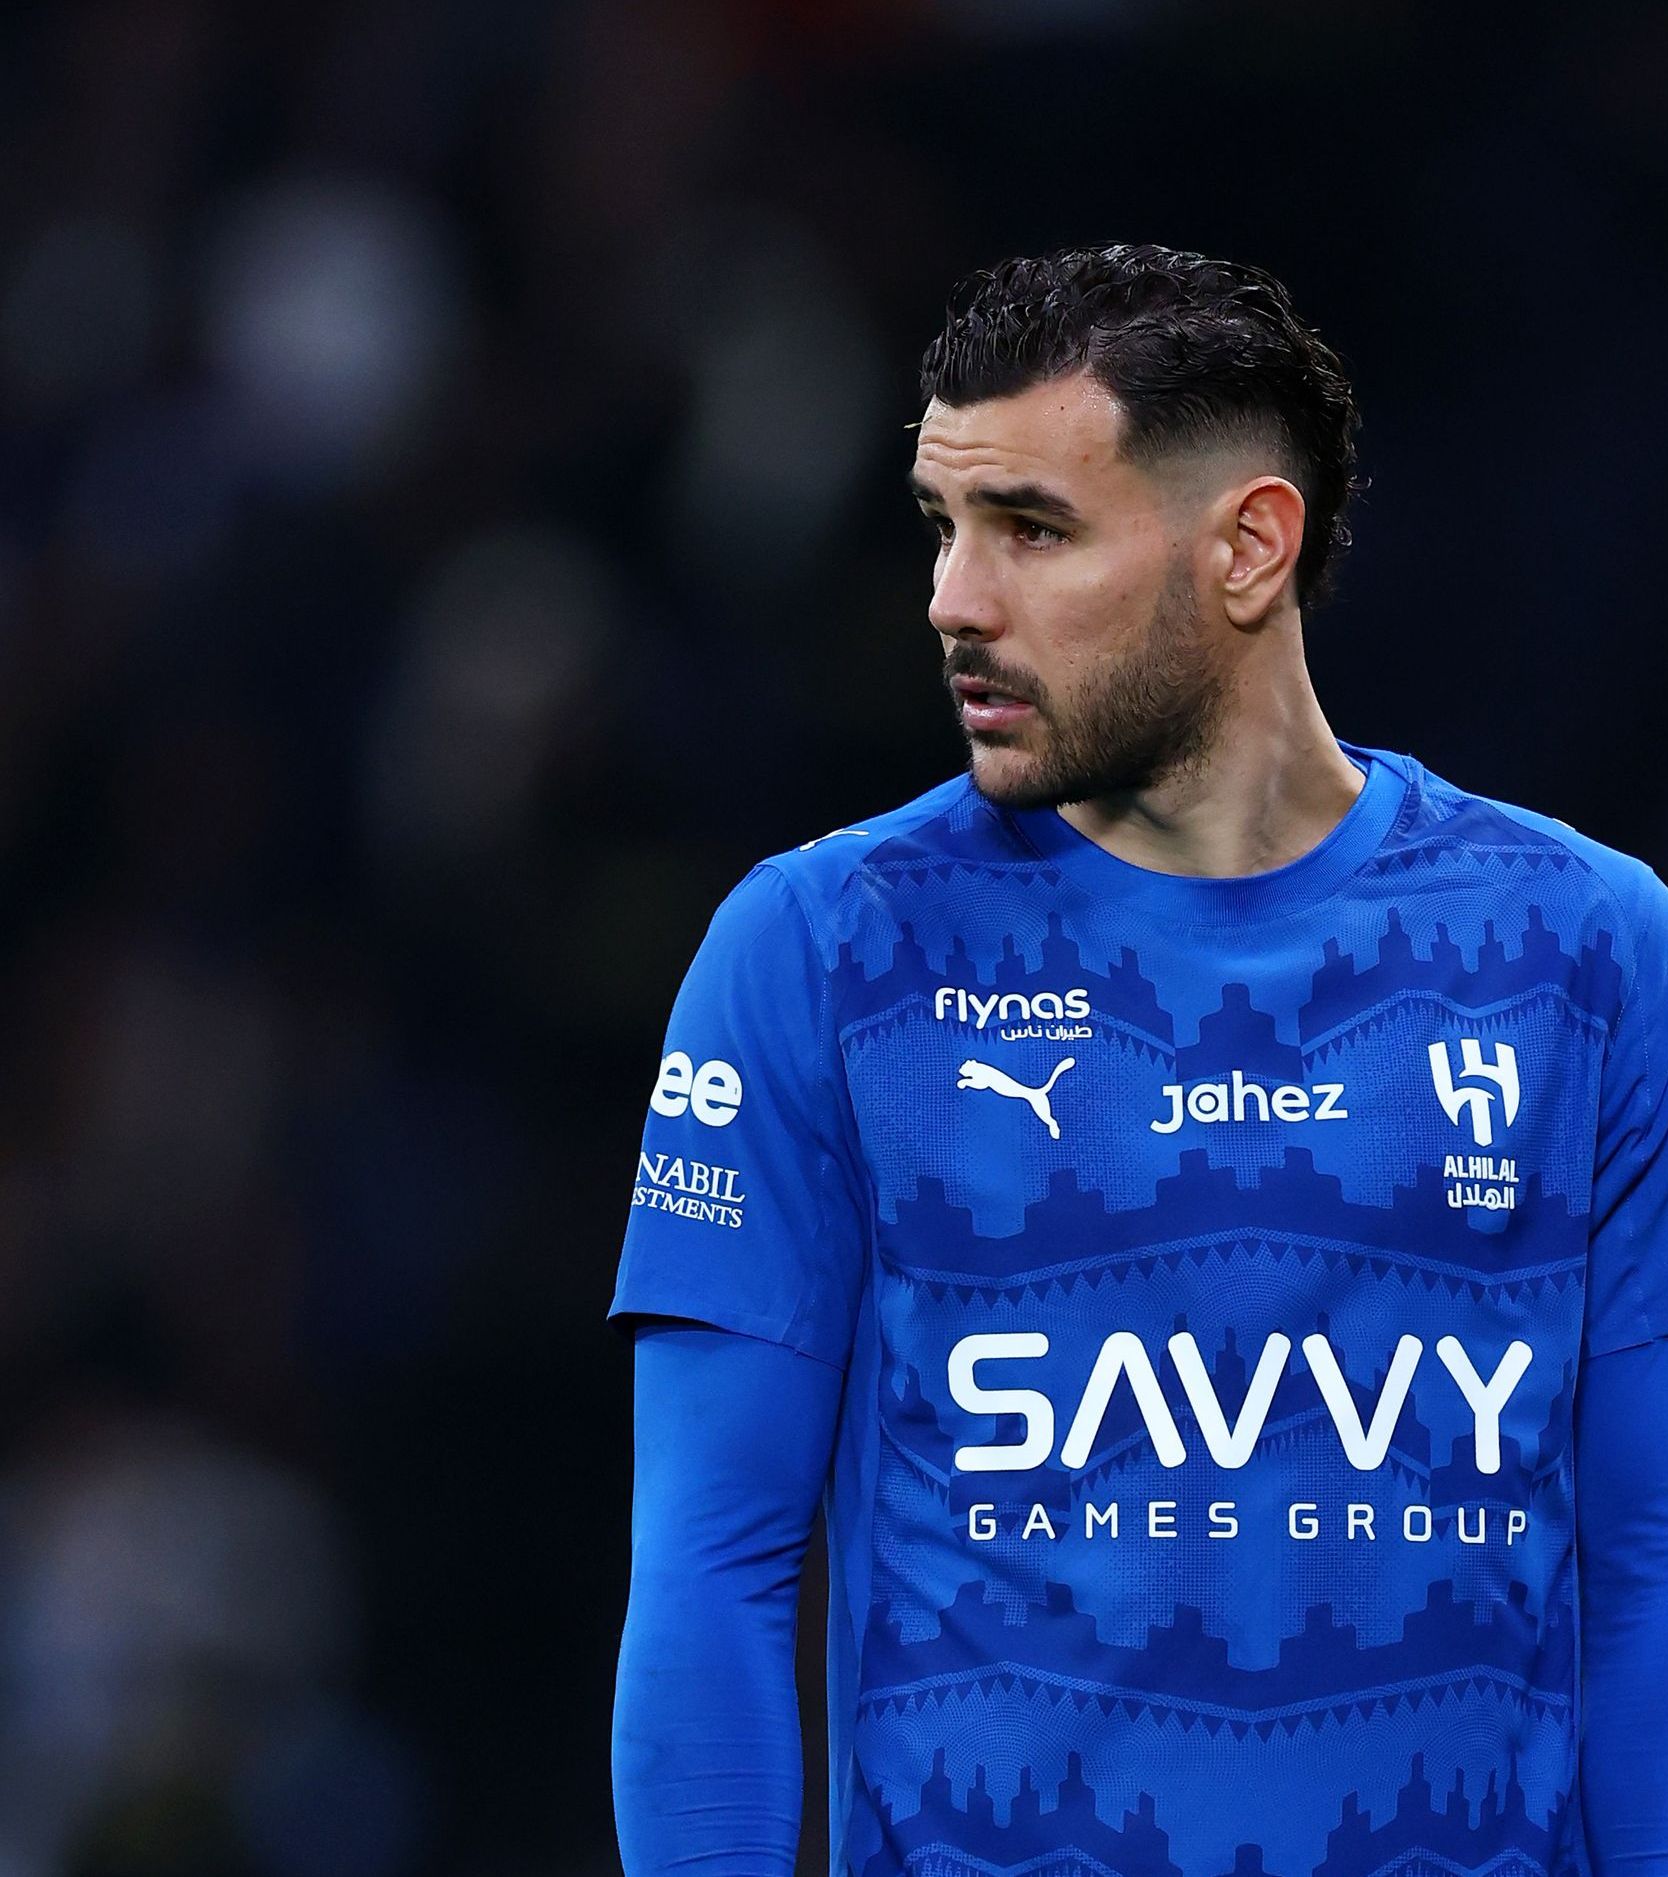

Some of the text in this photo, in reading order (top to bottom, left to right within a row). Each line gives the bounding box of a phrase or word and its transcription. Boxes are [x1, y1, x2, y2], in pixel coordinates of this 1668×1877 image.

[935, 987, 1091, 1030] flynas
[1000, 1024, 1093, 1042] طيران ناس
[1447, 1182, 1515, 1211] الهلال
[947, 1331, 1533, 1475] SAVVY
[968, 1501, 1527, 1546] GAMES GROUP
